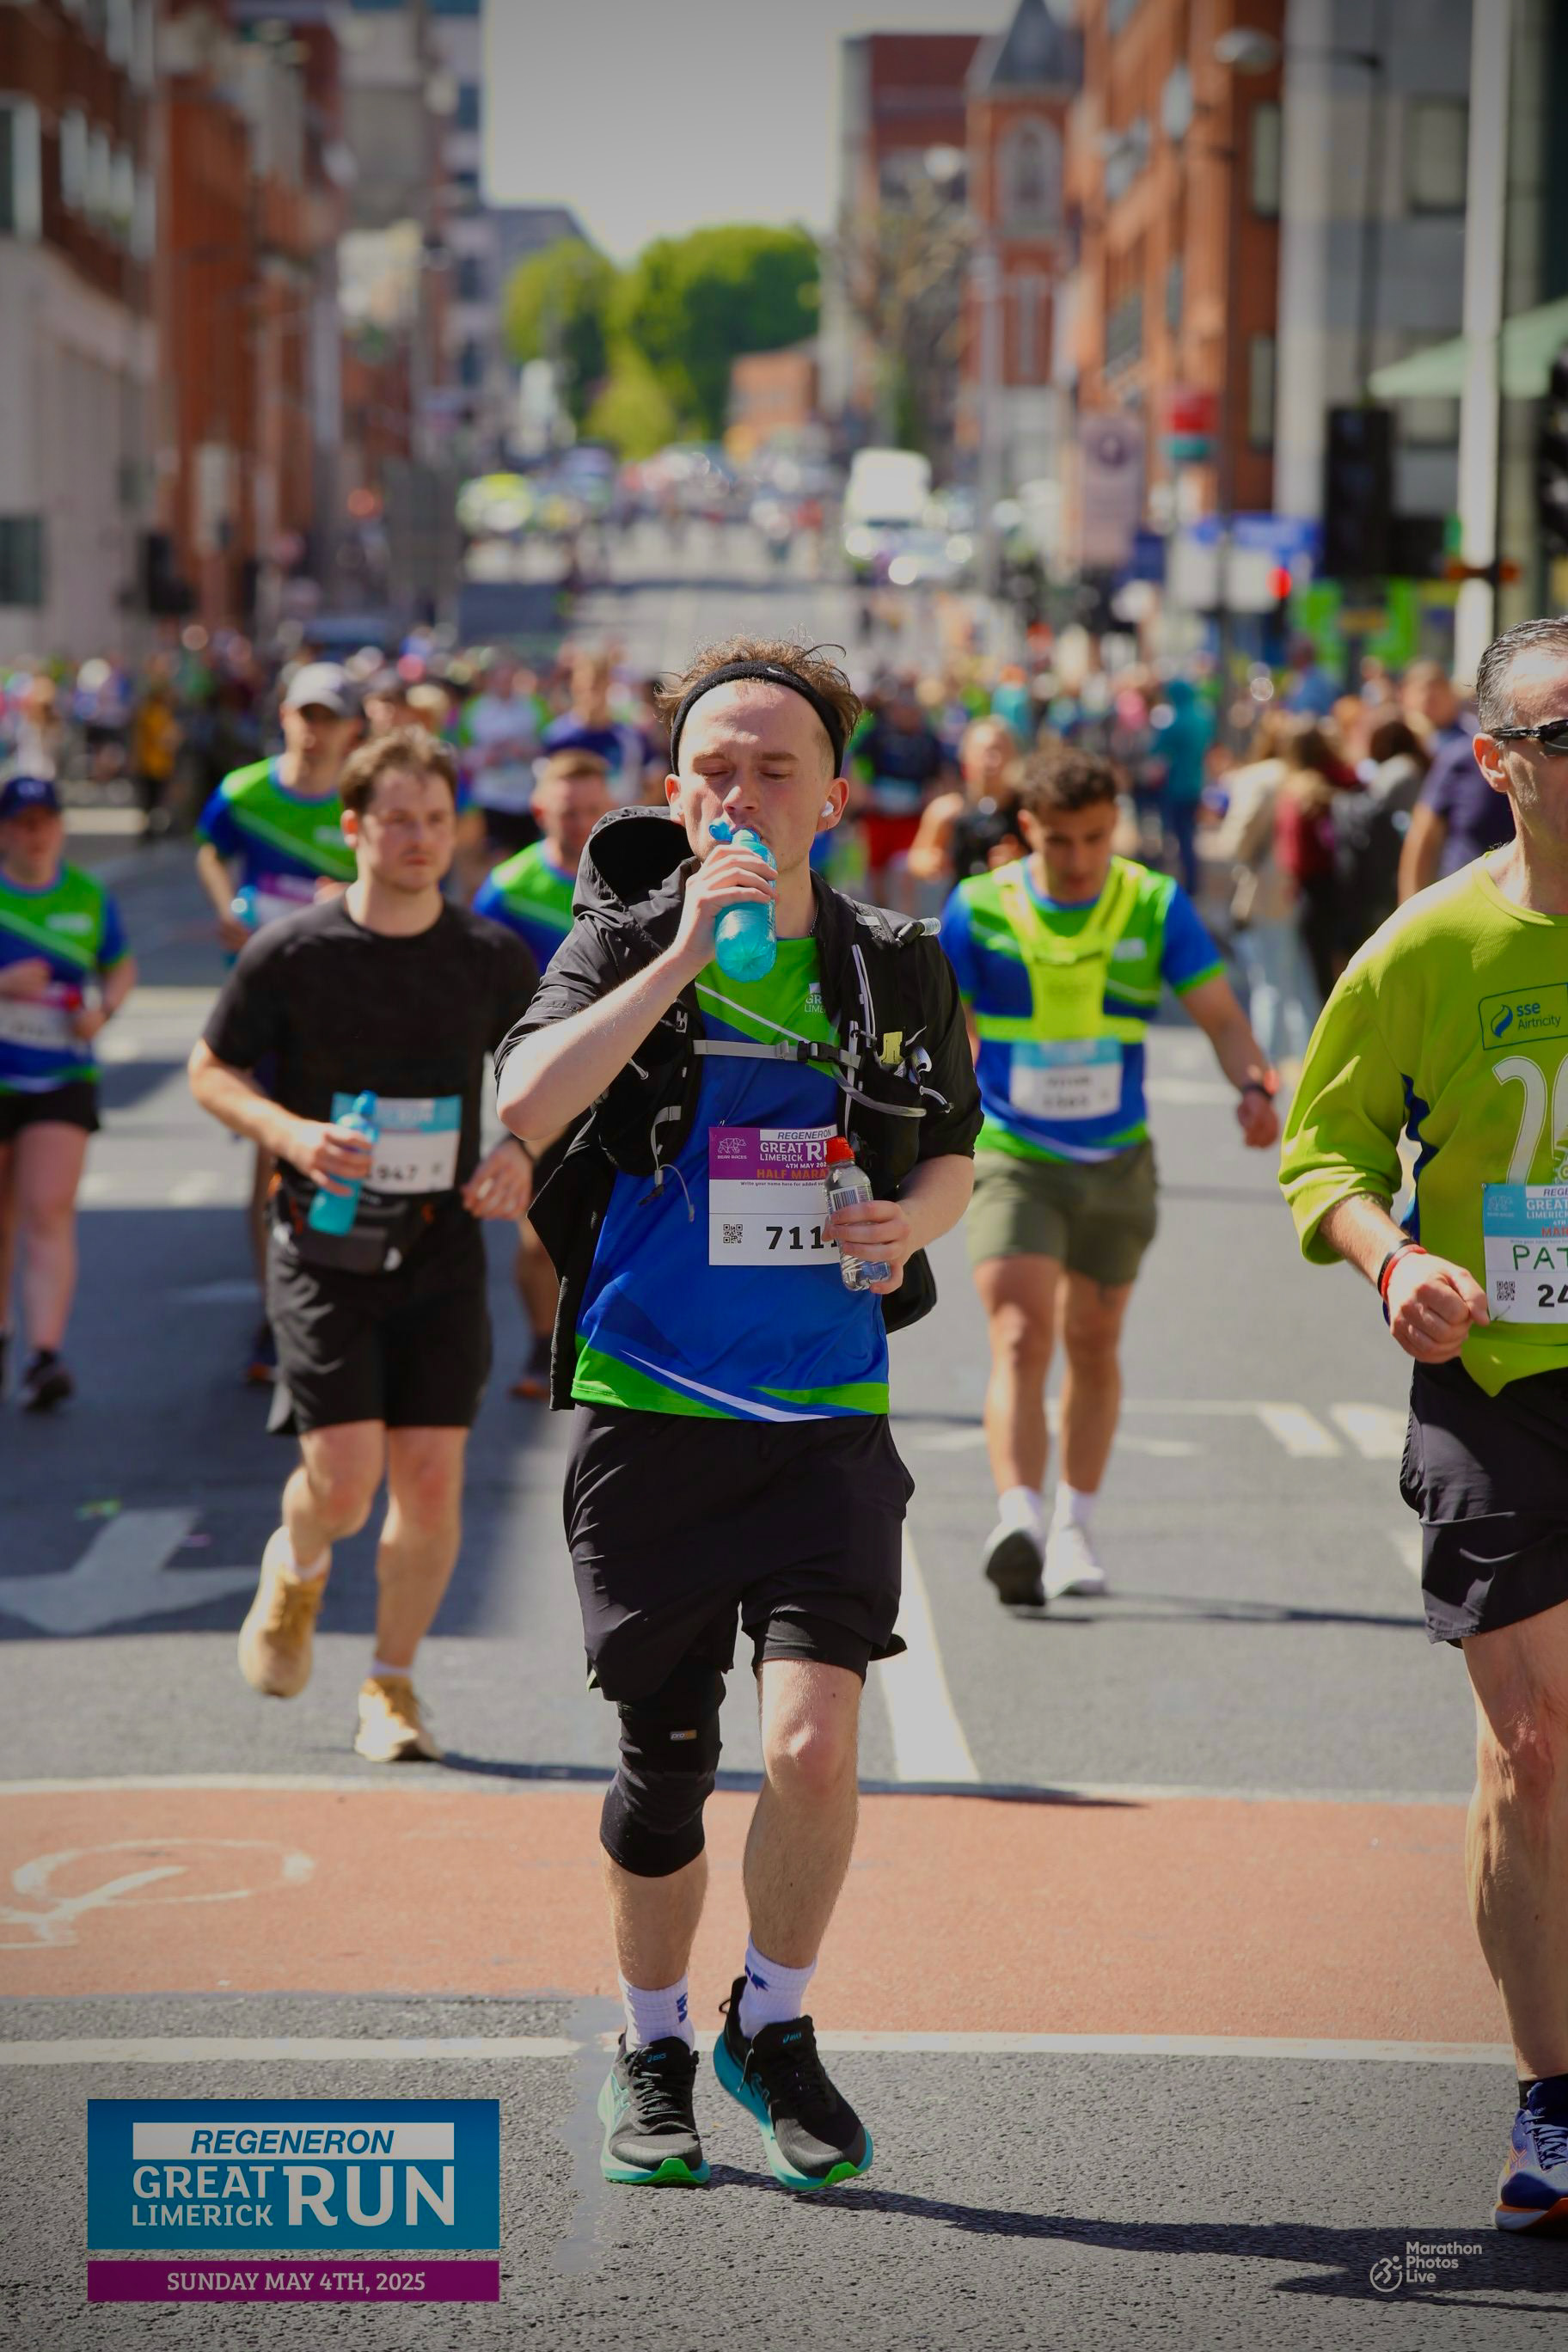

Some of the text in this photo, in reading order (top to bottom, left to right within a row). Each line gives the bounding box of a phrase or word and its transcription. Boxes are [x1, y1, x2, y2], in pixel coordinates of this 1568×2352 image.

[805, 1004, 825, 1014] LIME
[1516, 1002, 1540, 1017] sse
[1518, 1014, 1561, 1031] Airtricity
[777, 1130, 831, 1140] REGENERON
[760, 1142, 804, 1153] GREAT
[805, 1141, 827, 1161] R
[760, 1153, 804, 1161] LIMERICK
[756, 1169, 827, 1179] HALF MARA
[766, 1226, 837, 1249] 711
[1537, 1283, 1568, 1308] 24
